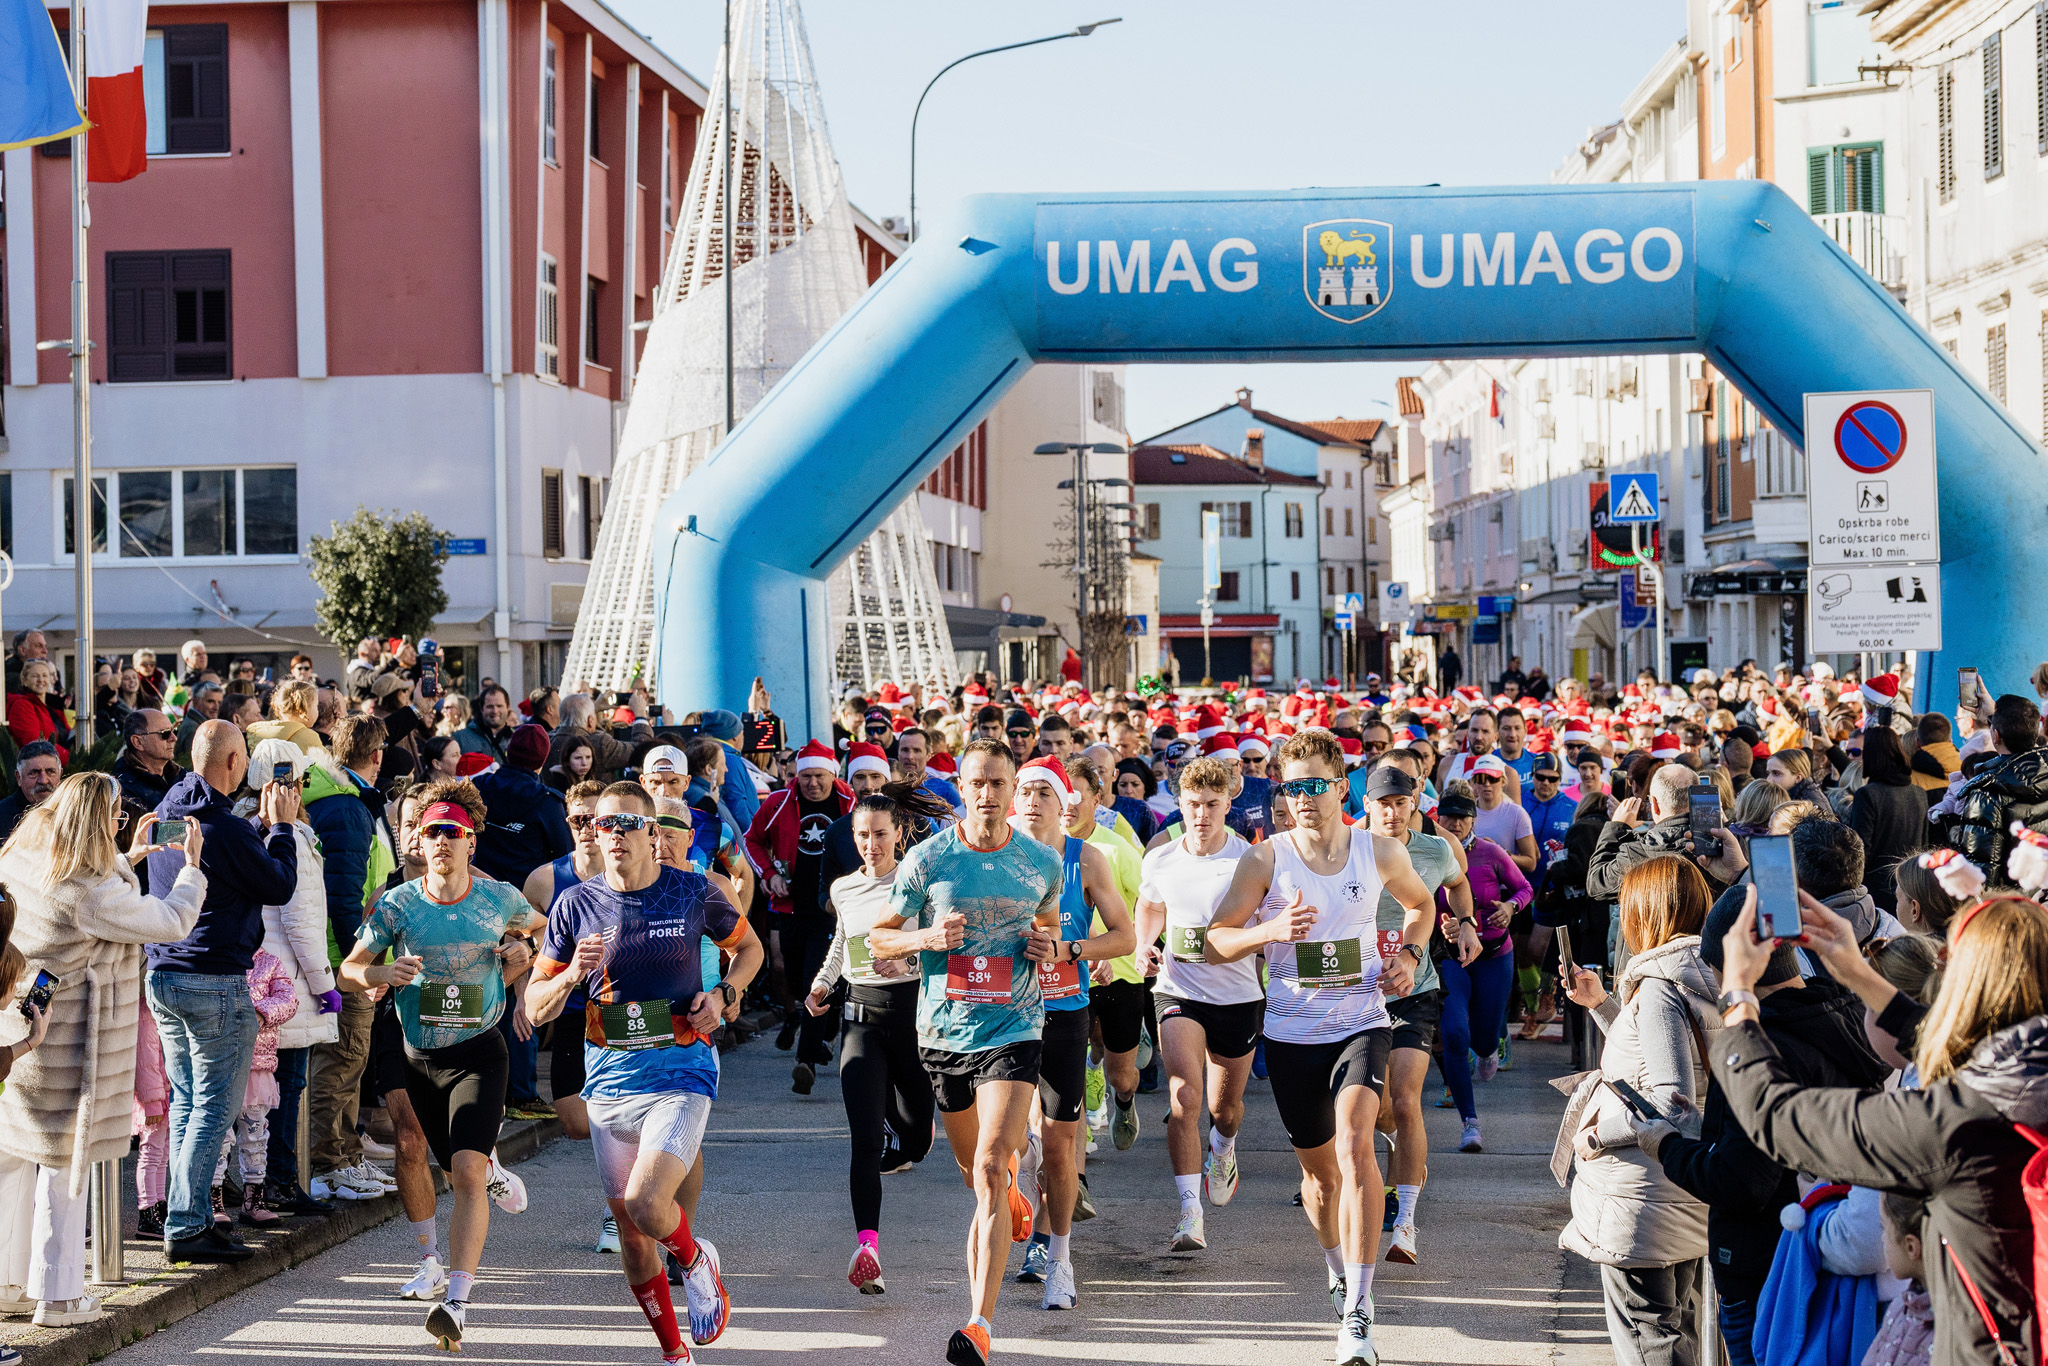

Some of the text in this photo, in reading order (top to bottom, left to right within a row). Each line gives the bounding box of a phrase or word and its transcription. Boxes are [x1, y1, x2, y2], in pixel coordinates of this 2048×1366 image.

[1046, 227, 1684, 295] UMAG UMAGO
[1838, 517, 1910, 530] Opskrba robe
[1819, 530, 1931, 545] Carico/scarico merci
[1843, 547, 1909, 558] Max. 10 min.
[1876, 613, 1905, 622] prometni
[1836, 629, 1859, 637] Penalty
[1859, 639, 1885, 648] 60,00
[755, 721, 774, 749] 2
[649, 925, 685, 938] POREČ
[1183, 939, 1201, 949] 294
[1383, 943, 1402, 952] 572
[1321, 957, 1339, 968] 50
[967, 971, 992, 983] 584
[1038, 972, 1060, 983] 430
[442, 998, 463, 1009] 104
[627, 1018, 646, 1031] 88
